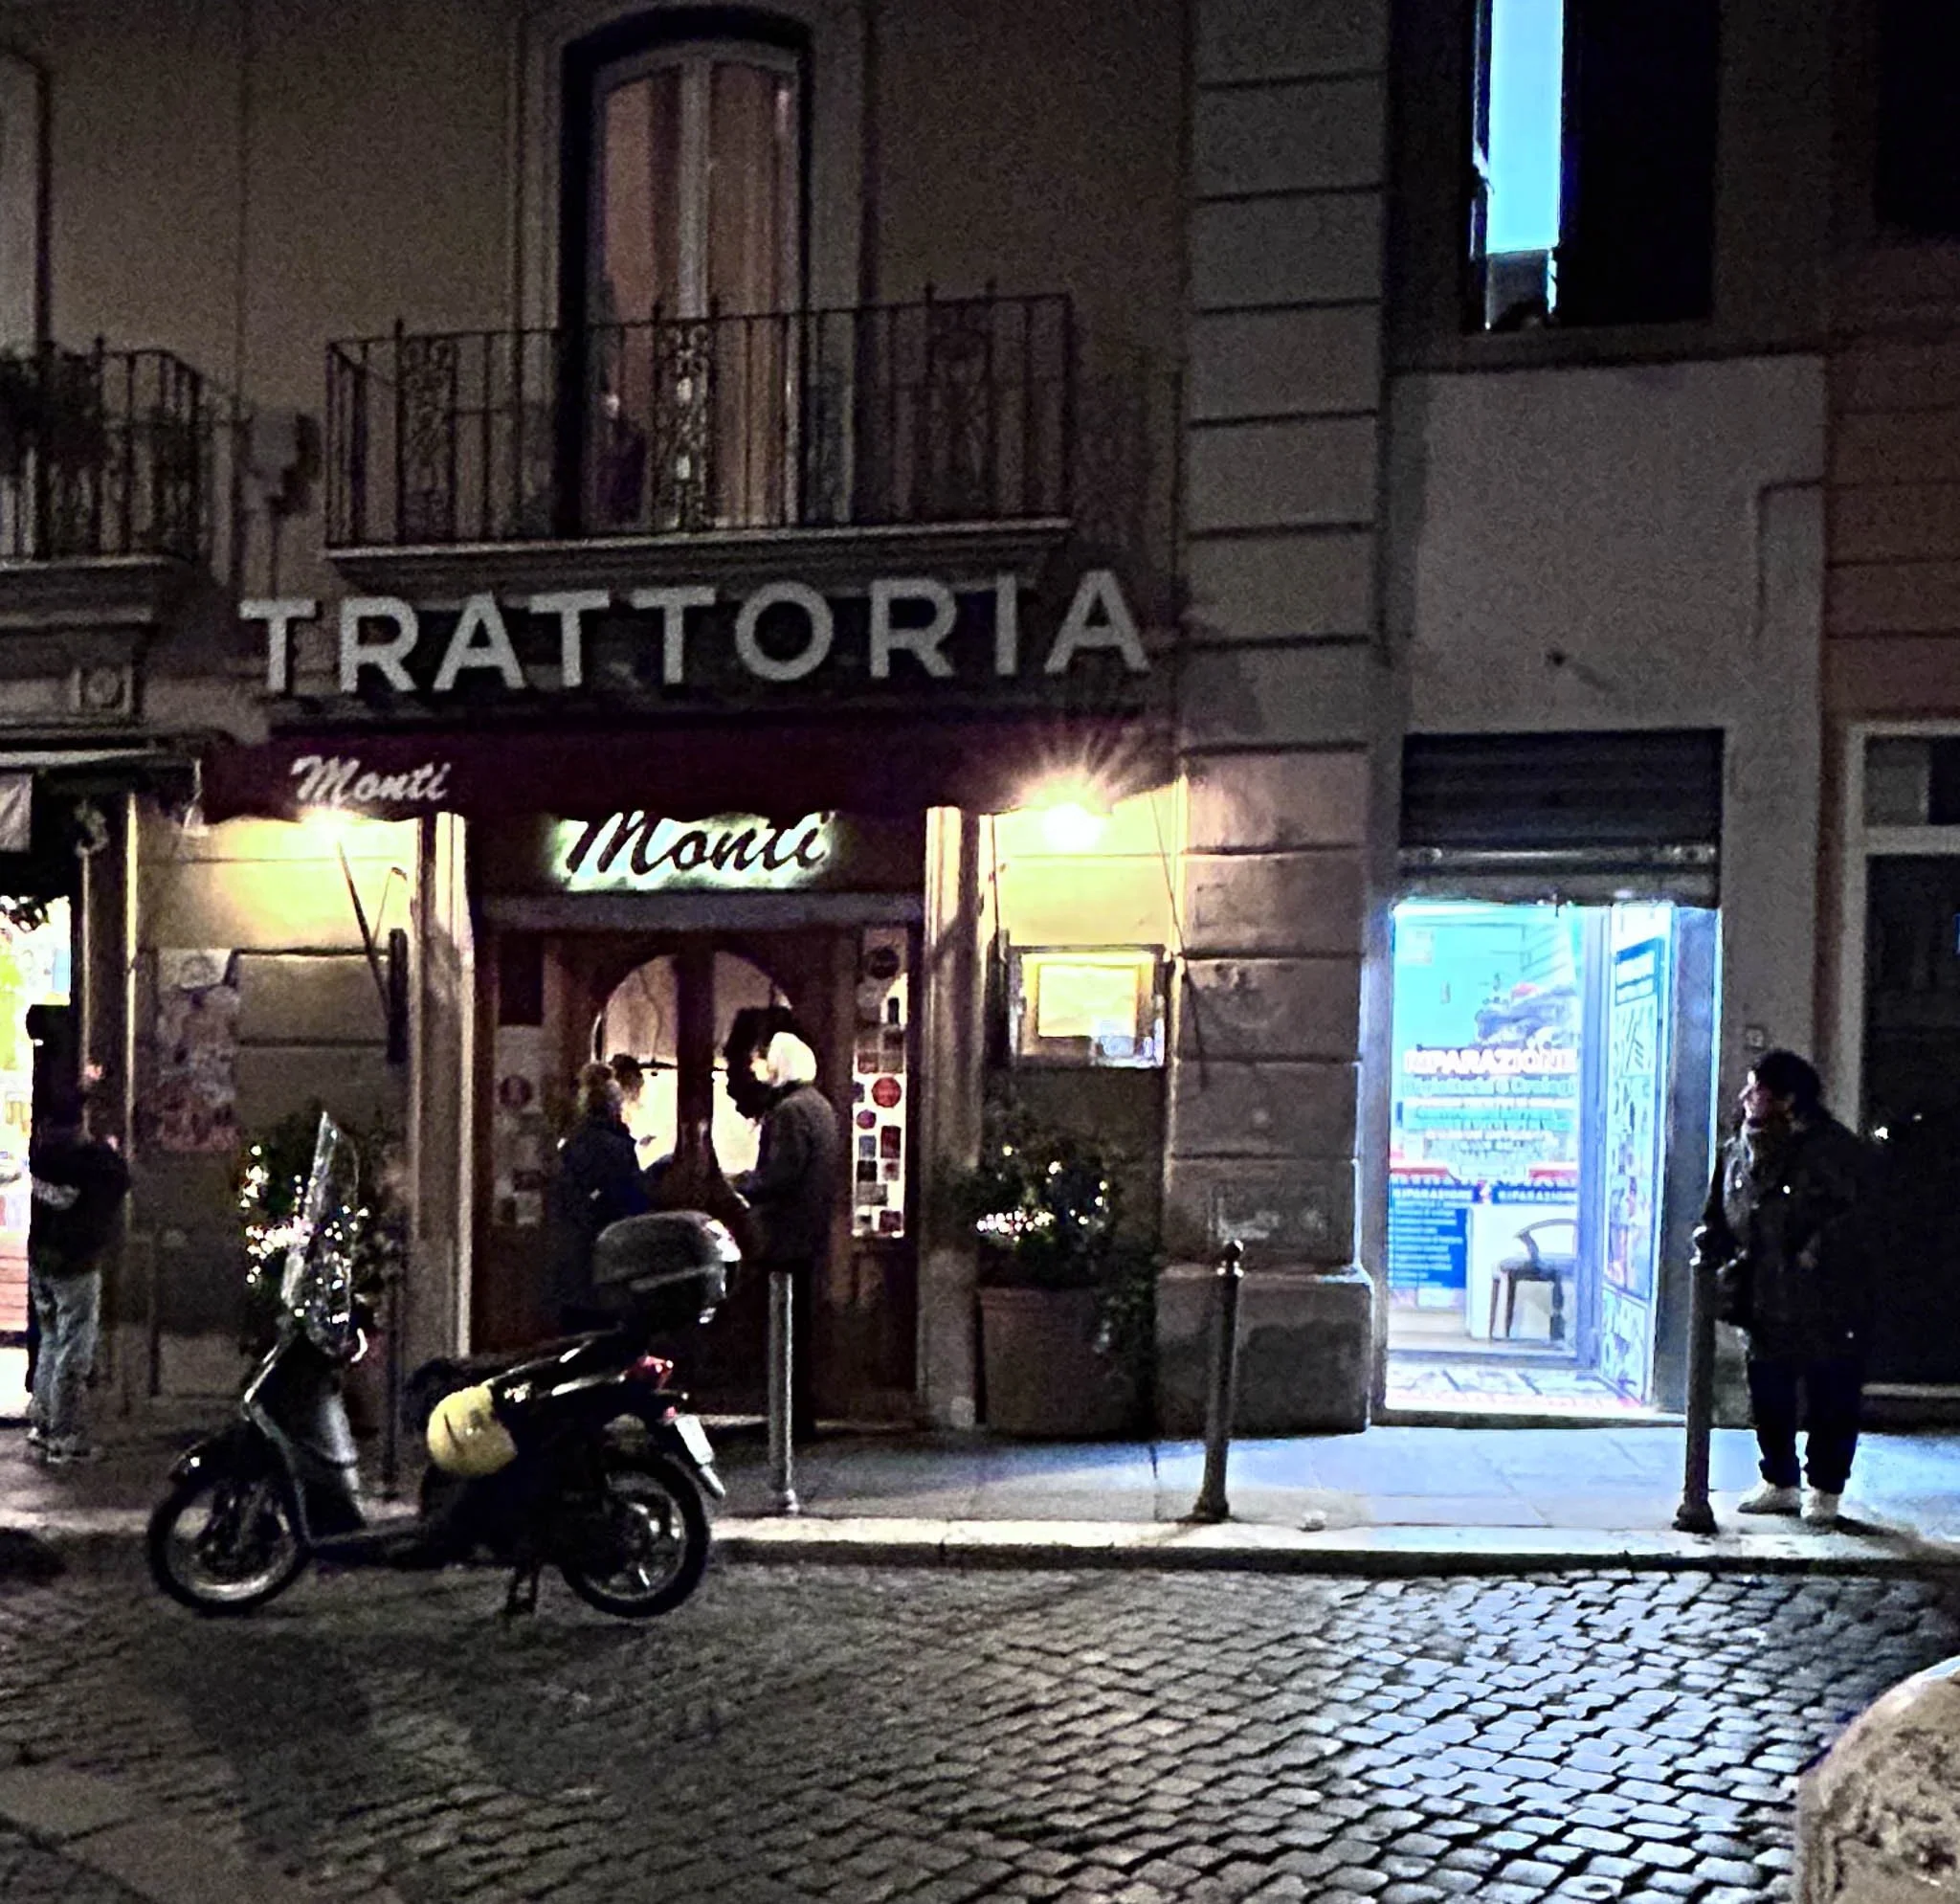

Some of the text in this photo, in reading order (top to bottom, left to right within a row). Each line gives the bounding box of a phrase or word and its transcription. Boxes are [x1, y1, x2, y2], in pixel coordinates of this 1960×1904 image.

[238, 569, 1149, 693] TRATTORIA
[290, 754, 452, 809] Monti
[563, 810, 836, 877] Monti
